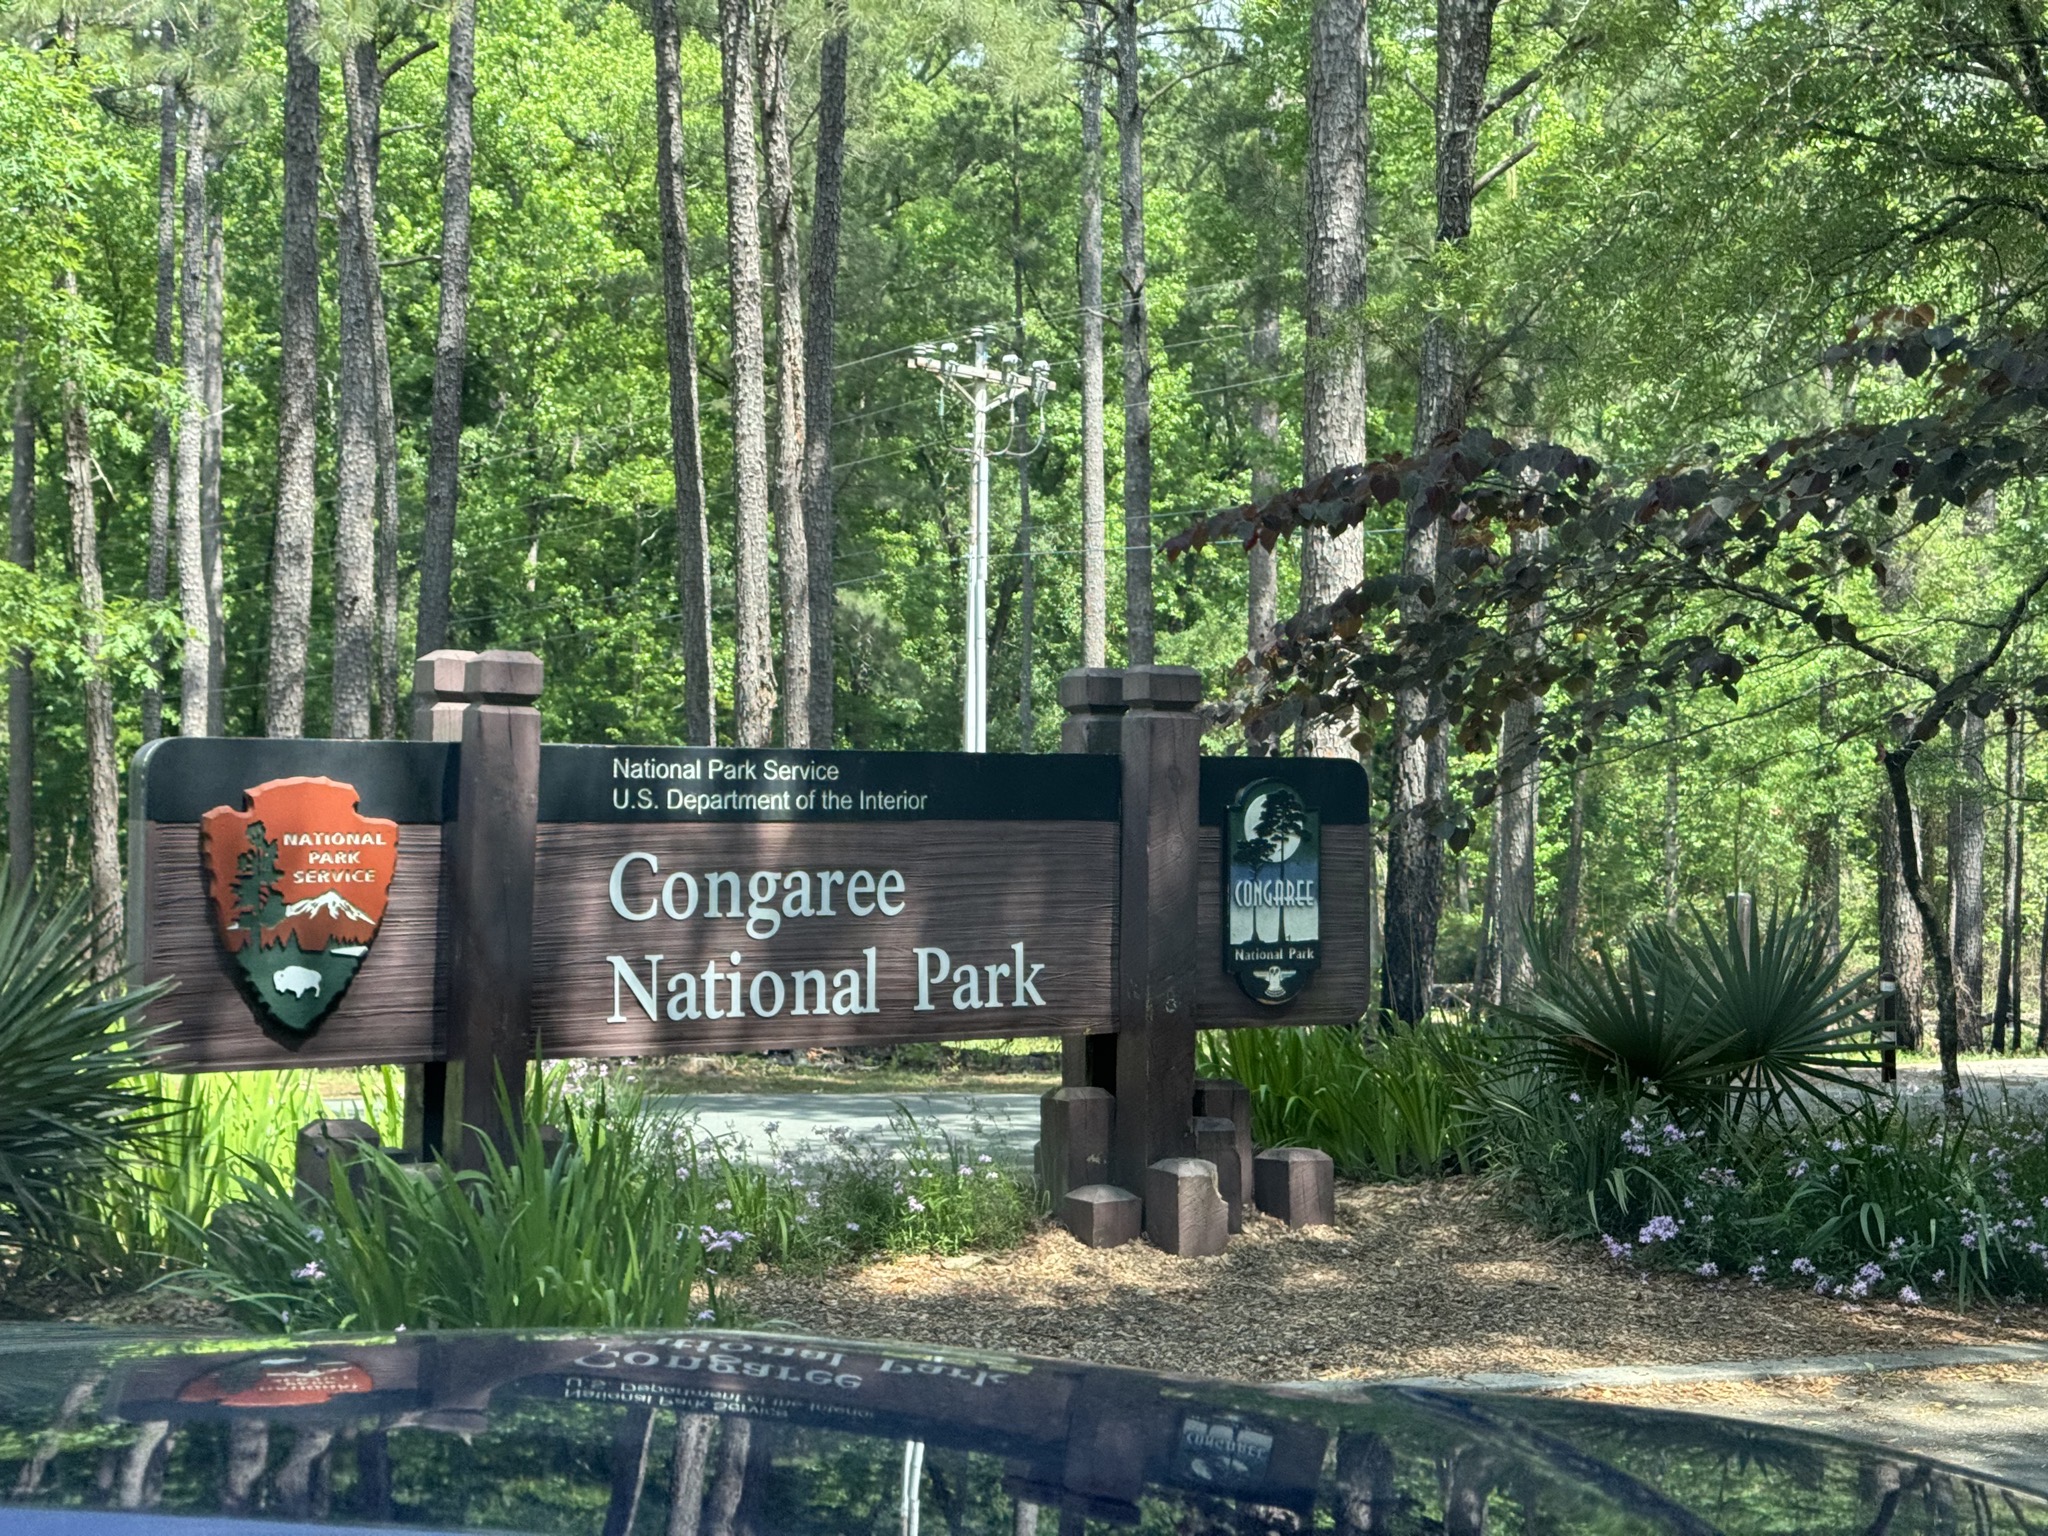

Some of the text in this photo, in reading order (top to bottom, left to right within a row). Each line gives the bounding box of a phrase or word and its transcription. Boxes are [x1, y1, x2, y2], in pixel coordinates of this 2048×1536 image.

[613, 758, 839, 780] National Park Service
[613, 788, 928, 815] U.S. Department of the Interior
[283, 832, 387, 846] NATIONAL
[308, 851, 361, 864] PARK
[293, 869, 376, 883] SERVICE
[608, 851, 906, 940] Congaree
[1234, 879, 1315, 907] CONGAREE
[1235, 948, 1315, 961] National Park
[606, 942, 1047, 1024] National Park
